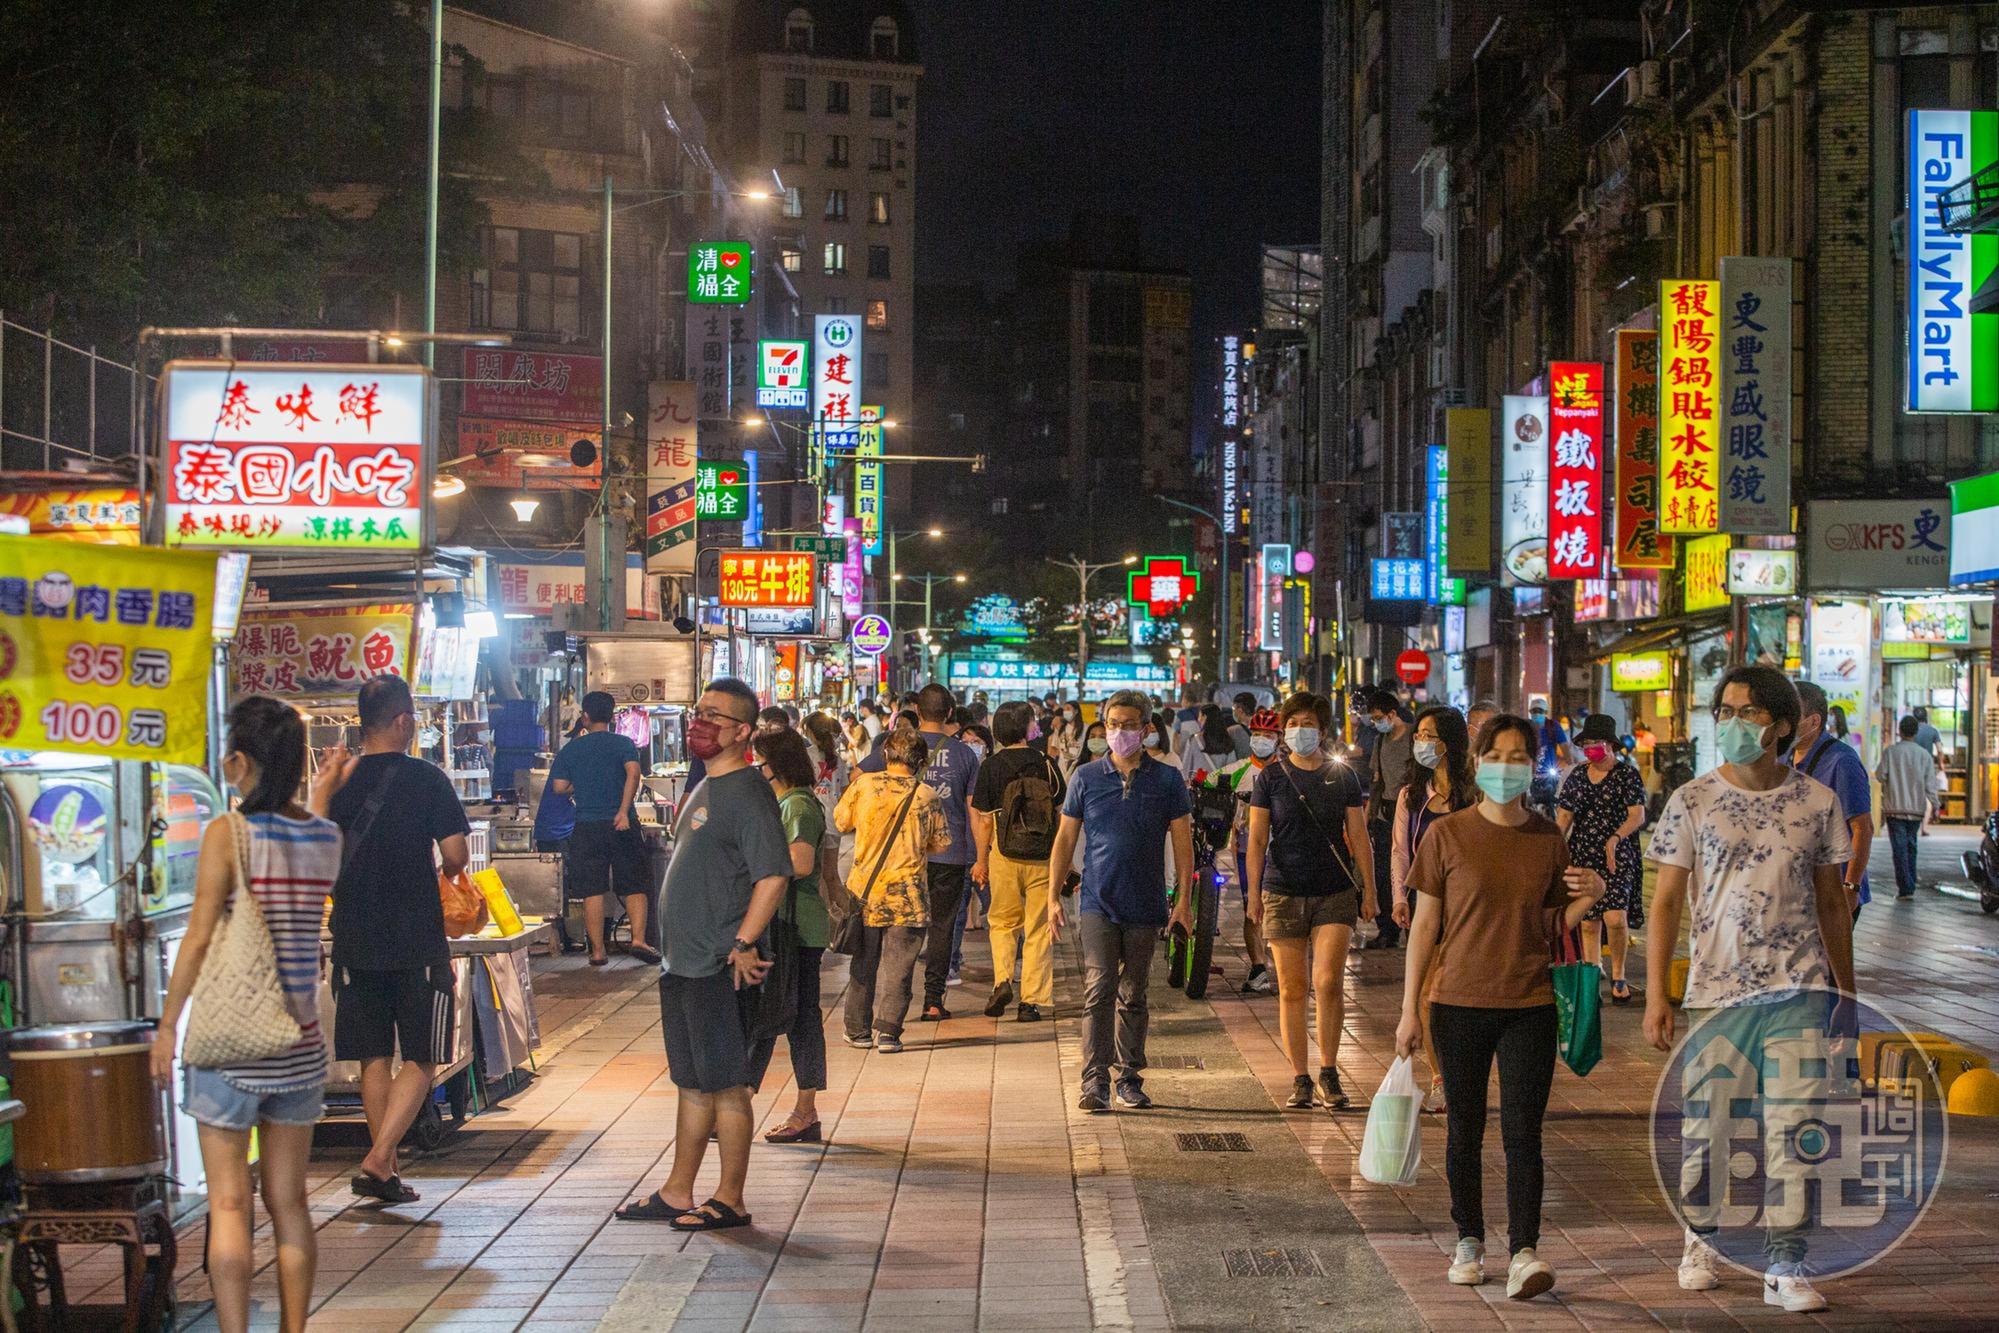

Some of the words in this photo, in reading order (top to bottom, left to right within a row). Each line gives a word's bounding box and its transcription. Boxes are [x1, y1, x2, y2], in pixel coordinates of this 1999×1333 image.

[696, 248, 718, 272] 清
[1919, 133, 1963, 386] FamilyMart
[216, 380, 382, 434] 泰味鮮
[823, 353, 853, 427] 建祥
[1554, 407, 1599, 417] Teppanyaki
[1666, 284, 1715, 492] 馥陽鍋貼水餃
[1728, 291, 1770, 505] 更豐盛眼鏡
[654, 396, 692, 467] 九龍
[174, 444, 414, 506] 泰國小吃
[860, 430, 876, 514] 小北百貨
[1555, 428, 1597, 568] 鐵板燒
[1664, 496, 1719, 530] 專賣店
[178, 512, 282, 539] 泰味現炒
[303, 515, 409, 541] 涼拌木瓜
[656, 529, 688, 551] 文具
[1863, 524, 1905, 550] KFS
[1910, 508, 1948, 552] 更
[721, 579, 759, 602] 130元
[723, 559, 757, 577] 寧夏
[760, 557, 810, 603] 牛排
[66, 641, 171, 689] 35元
[238, 624, 301, 658] 爆脆
[307, 631, 401, 681] 魷魚
[42, 699, 168, 747] 100元
